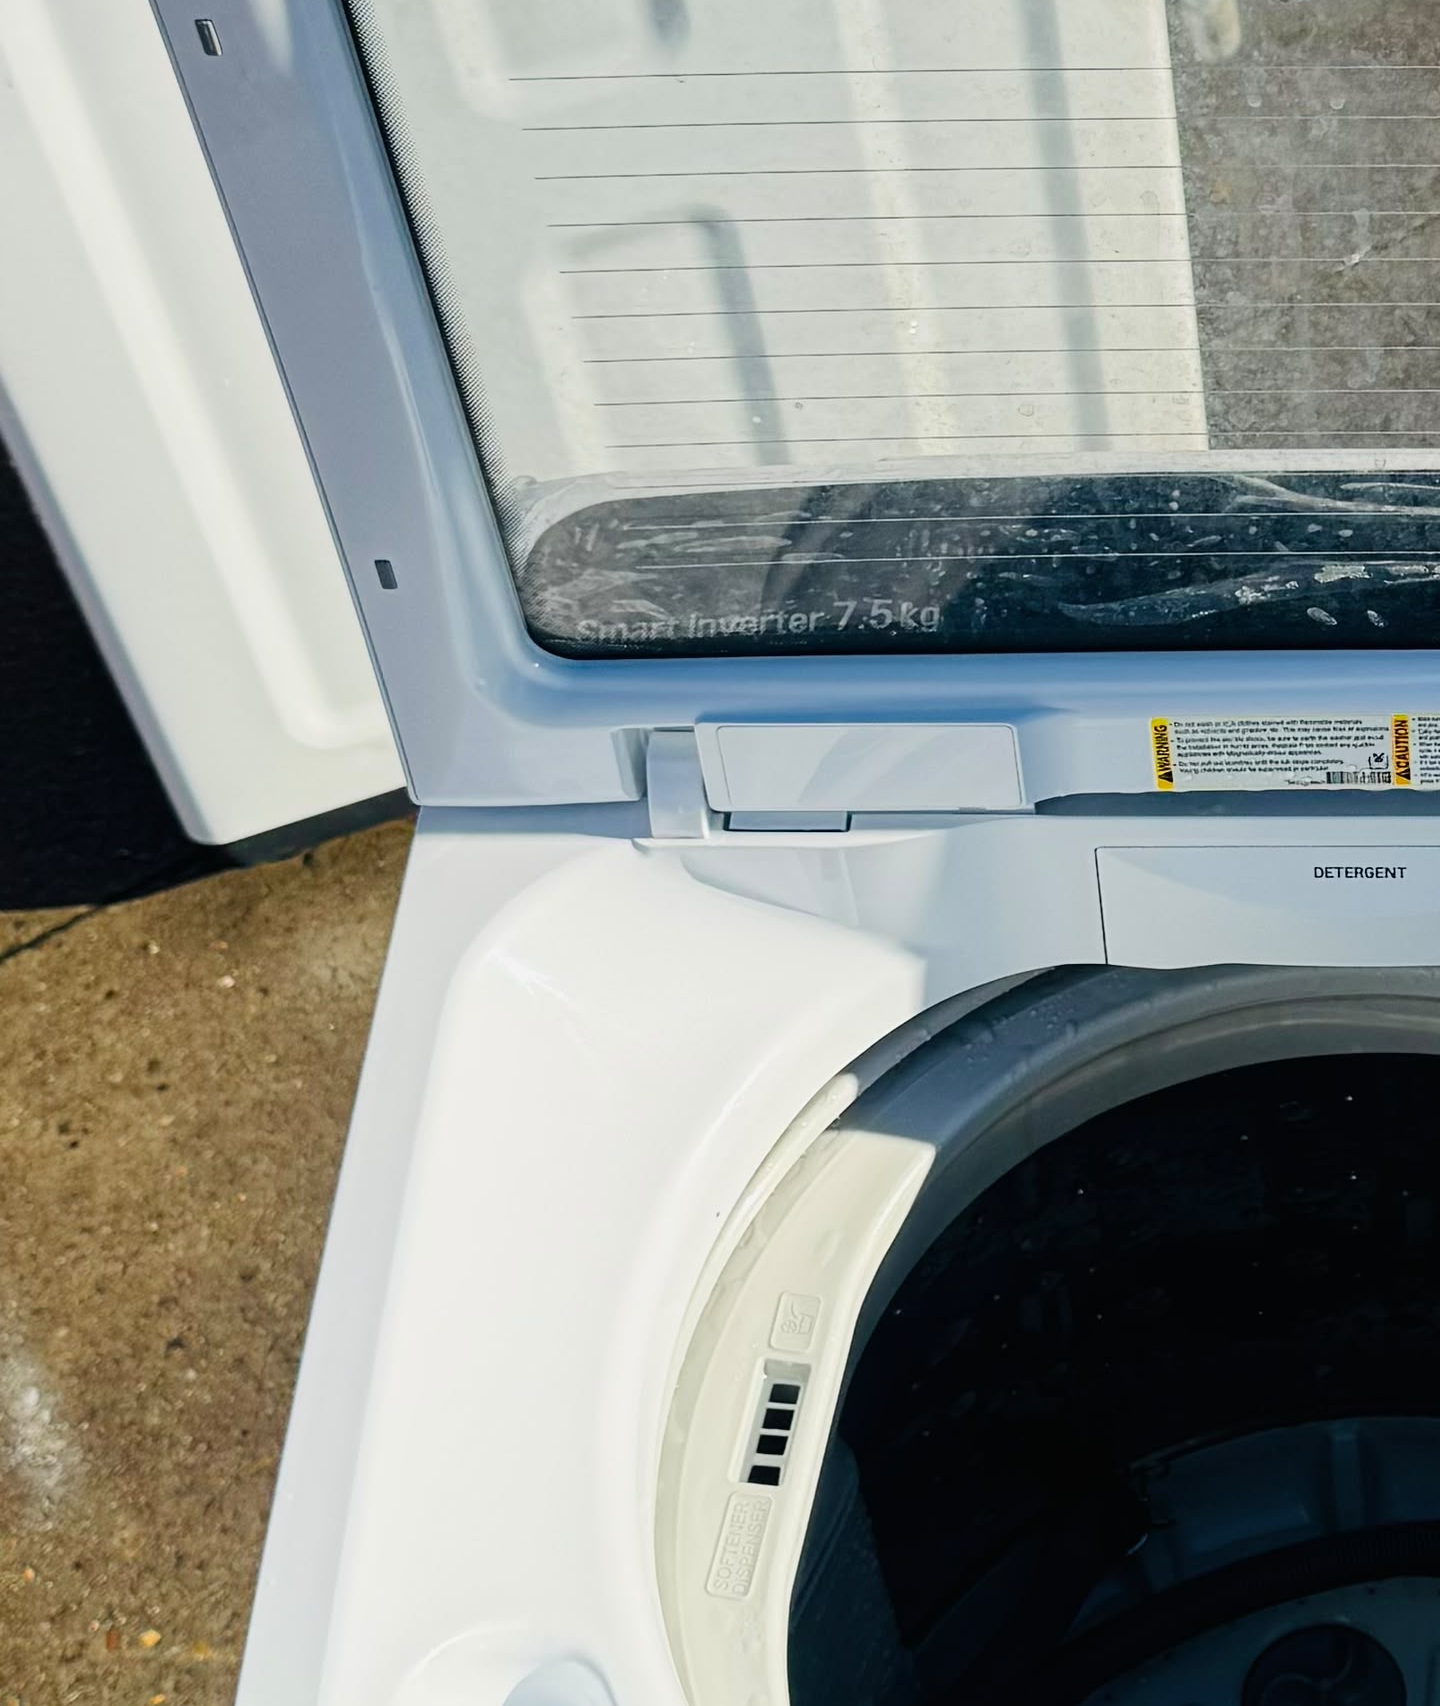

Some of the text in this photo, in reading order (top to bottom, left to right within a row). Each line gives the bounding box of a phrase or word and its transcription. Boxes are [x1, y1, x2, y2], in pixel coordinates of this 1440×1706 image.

[687, 609, 825, 638] Inverter
[1153, 724, 1170, 770] WARNING
[1395, 719, 1410, 771] CAUTION
[1313, 866, 1407, 880] DETERGENT
[713, 1501, 750, 1590] SOFTENER
[732, 1500, 770, 1594] DISPENSER
